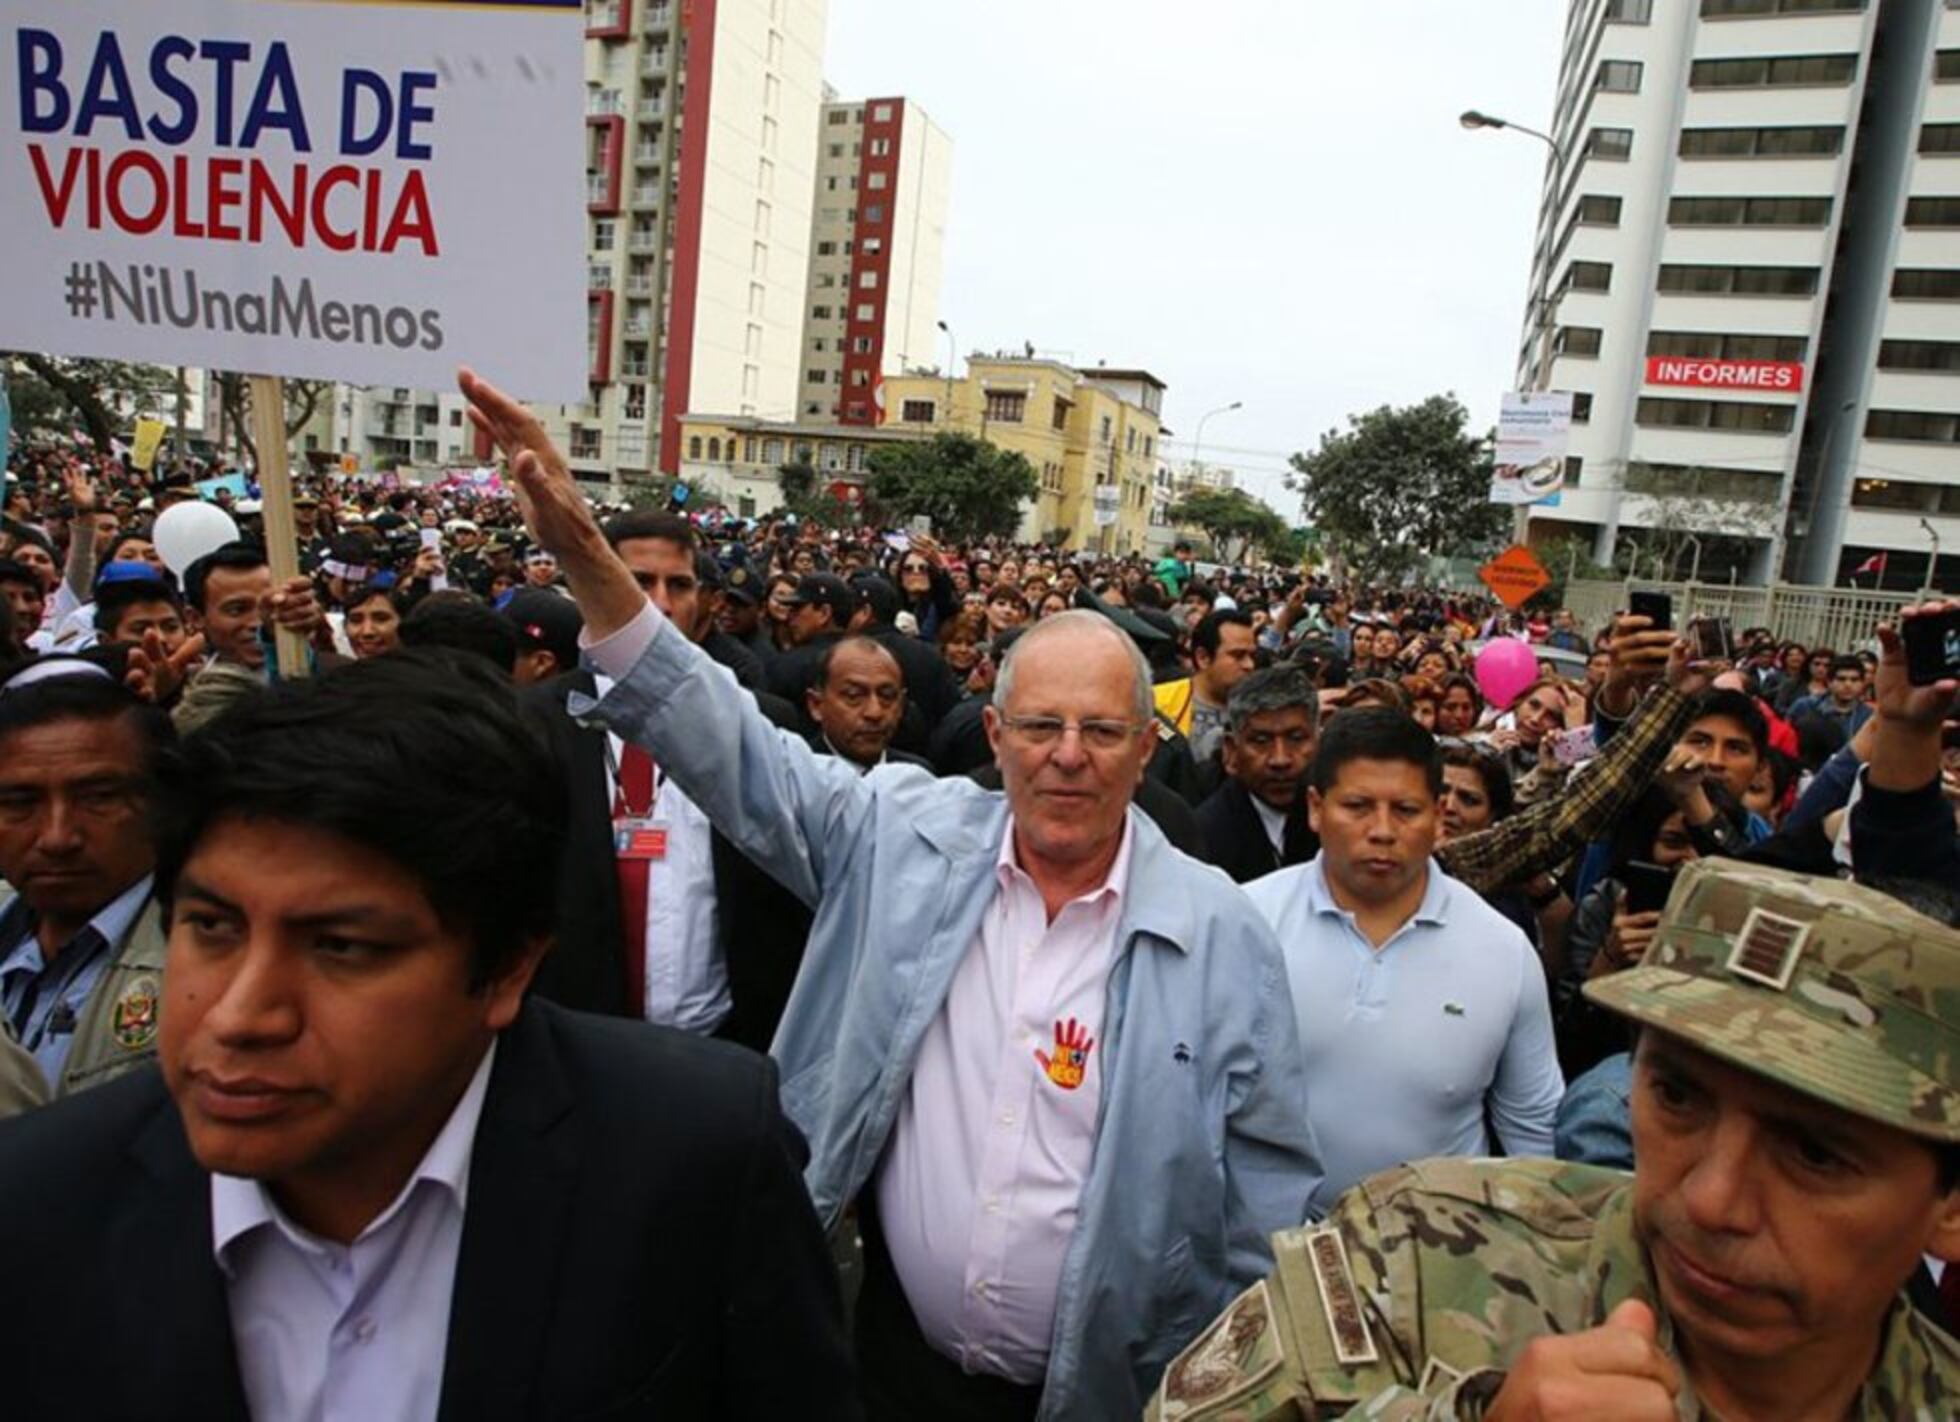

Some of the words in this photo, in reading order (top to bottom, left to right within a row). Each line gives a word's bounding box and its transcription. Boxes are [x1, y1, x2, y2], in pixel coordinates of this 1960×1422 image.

[16, 27, 311, 152] BASTA
[340, 68, 437, 160] DE
[27, 144, 439, 256] VIOLENCIA
[64, 260, 443, 351] #NiUnaMenos
[1657, 361, 1792, 387] INFORMES
